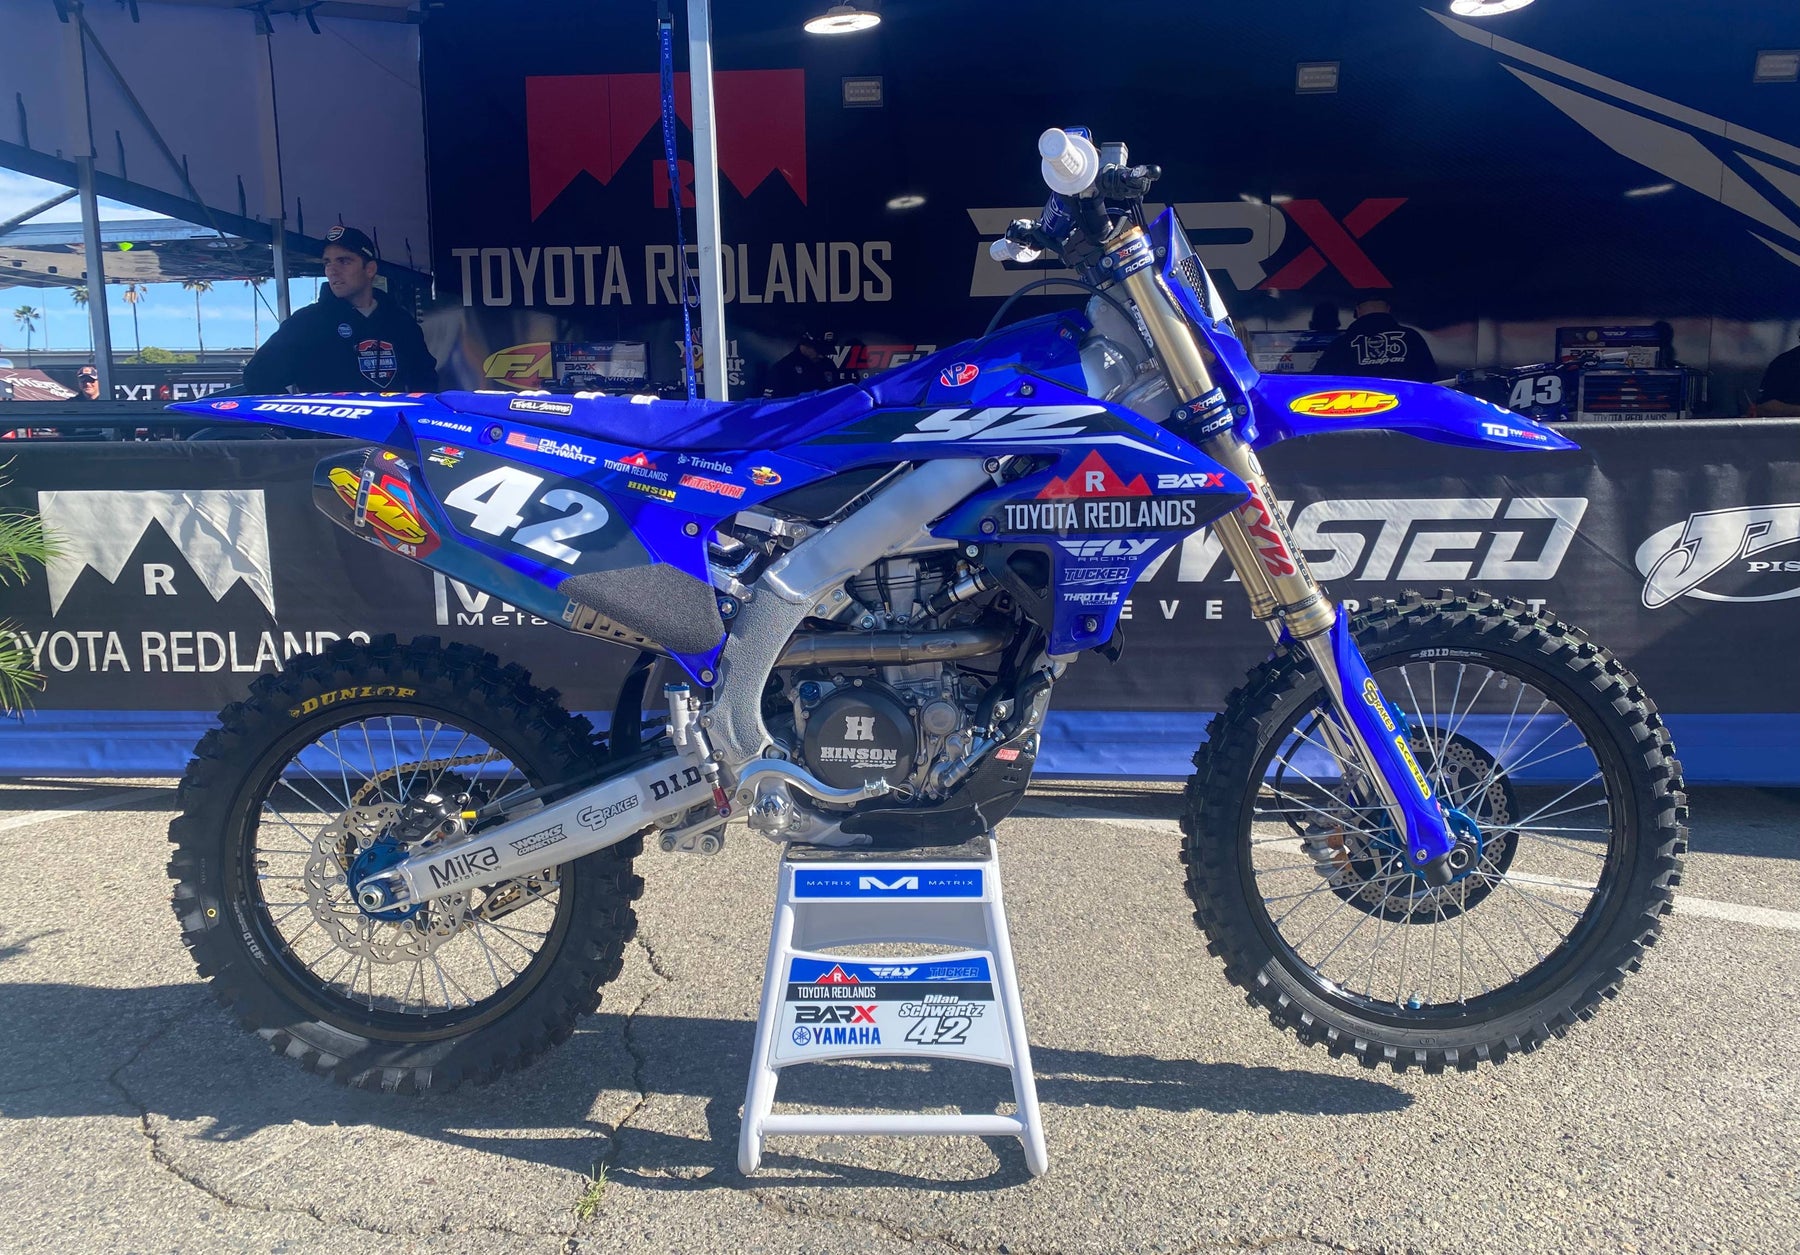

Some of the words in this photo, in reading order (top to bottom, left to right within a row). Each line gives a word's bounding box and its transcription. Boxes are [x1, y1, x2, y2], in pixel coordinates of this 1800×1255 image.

[1116, 242, 1143, 258] XTRIG
[1125, 256, 1151, 273] ROCS
[452, 247, 632, 307] TOYOTA
[564, 363, 597, 371] BARX
[1361, 357, 1406, 366] Snap-on
[942, 362, 966, 386] VP
[1509, 375, 1562, 409] 43
[252, 403, 373, 419] DUNLOP
[1189, 393, 1223, 413] XTRIG
[1292, 393, 1397, 412] FMF
[430, 420, 472, 433] YAMAHA
[891, 405, 1107, 443] YZ
[1202, 415, 1233, 434] ROCS
[538, 445, 597, 465] SCHWARTZ
[540, 438, 582, 454] DILAN
[604, 459, 630, 475] TOYOTA
[631, 465, 669, 482] REDLANDS
[636, 457, 644, 465] R
[690, 456, 734, 475] Trimble
[627, 480, 677, 499] HINSON
[1085, 471, 1106, 492] R
[1157, 473, 1225, 489] BARX
[443, 465, 609, 565] 42
[1005, 503, 1078, 530] TOYOTA
[1084, 500, 1196, 528] REDLANDS
[1261, 485, 1314, 588] SUSPENSION
[1056, 539, 1160, 557] FLY
[143, 563, 178, 595] R
[1064, 566, 1130, 581] TUCKER
[1064, 592, 1120, 602] THROTTLE
[301, 686, 416, 715] DUNLOP
[844, 716, 875, 741] H
[820, 746, 898, 761] HINSON
[1396, 740, 1430, 797] ACERBIS
[650, 765, 702, 801] D.I.D
[510, 824, 563, 850] WORKS
[517, 833, 568, 857] CONNECTION
[428, 846, 500, 889] Mika
[442, 871, 481, 888] Metals
[834, 973, 842, 982] R
[868, 967, 918, 977] FLY
[929, 967, 980, 978] TUCKER
[798, 986, 830, 999] TOYOTA
[832, 986, 876, 999] REDLANDS
[923, 994, 959, 1004] Dilan
[794, 1005, 879, 1024] BARX
[898, 1002, 986, 1018] Schwartz
[812, 1027, 881, 1045] YAMAHA
[904, 1015, 973, 1045] 42
